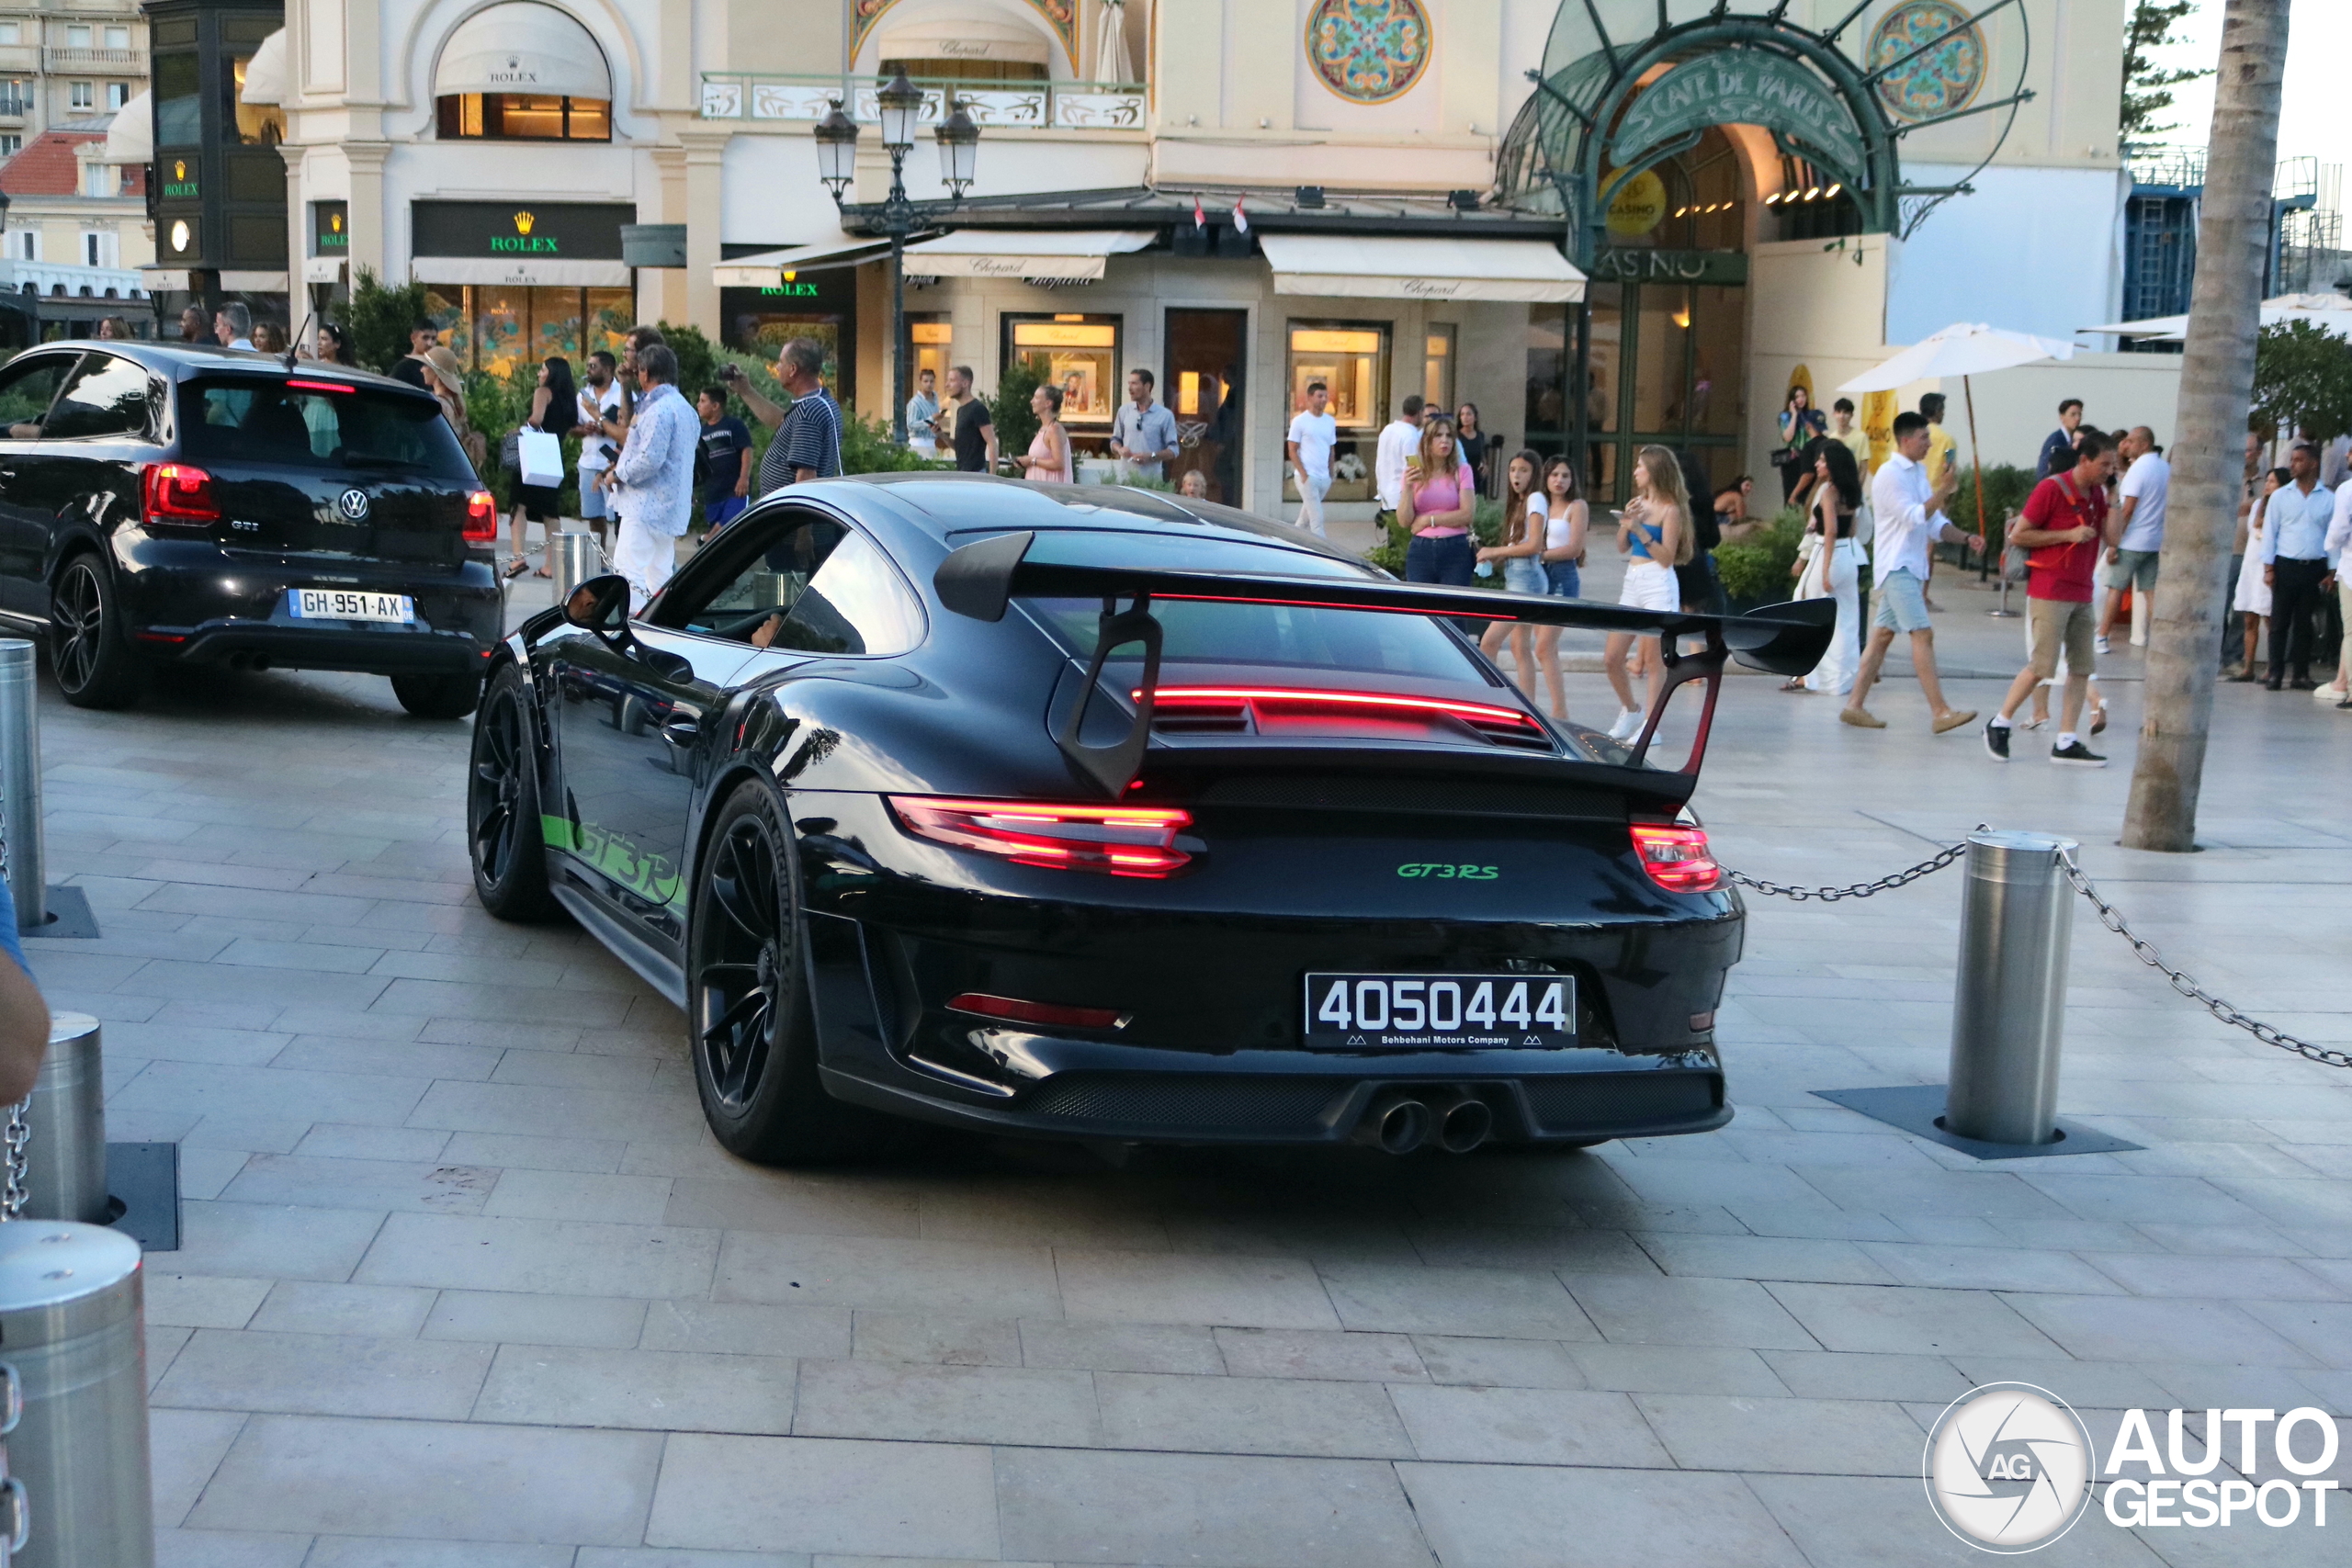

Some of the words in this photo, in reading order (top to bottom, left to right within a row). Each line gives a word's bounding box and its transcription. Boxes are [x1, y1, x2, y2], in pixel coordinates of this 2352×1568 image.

[939, 40, 991, 59] Chopard
[491, 73, 537, 83] ROLEX
[1718, 70, 1747, 96] DE
[1757, 70, 1834, 127] PARIS
[165, 183, 198, 197] ROLEX
[491, 236, 559, 252] ROLEX
[969, 257, 1027, 276] Chopard
[505, 276, 537, 285] ROLEX
[1400, 278, 1462, 298] Chopard
[232, 520, 259, 531] GTI
[404, 610, 413, 621] 06
[1397, 863, 1498, 879] GT3RS
[1318, 980, 1566, 1031] 4050444
[1382, 1035, 1431, 1044] Behbehani
[1433, 1035, 1465, 1044] Motors
[1468, 1035, 1510, 1046] Company
